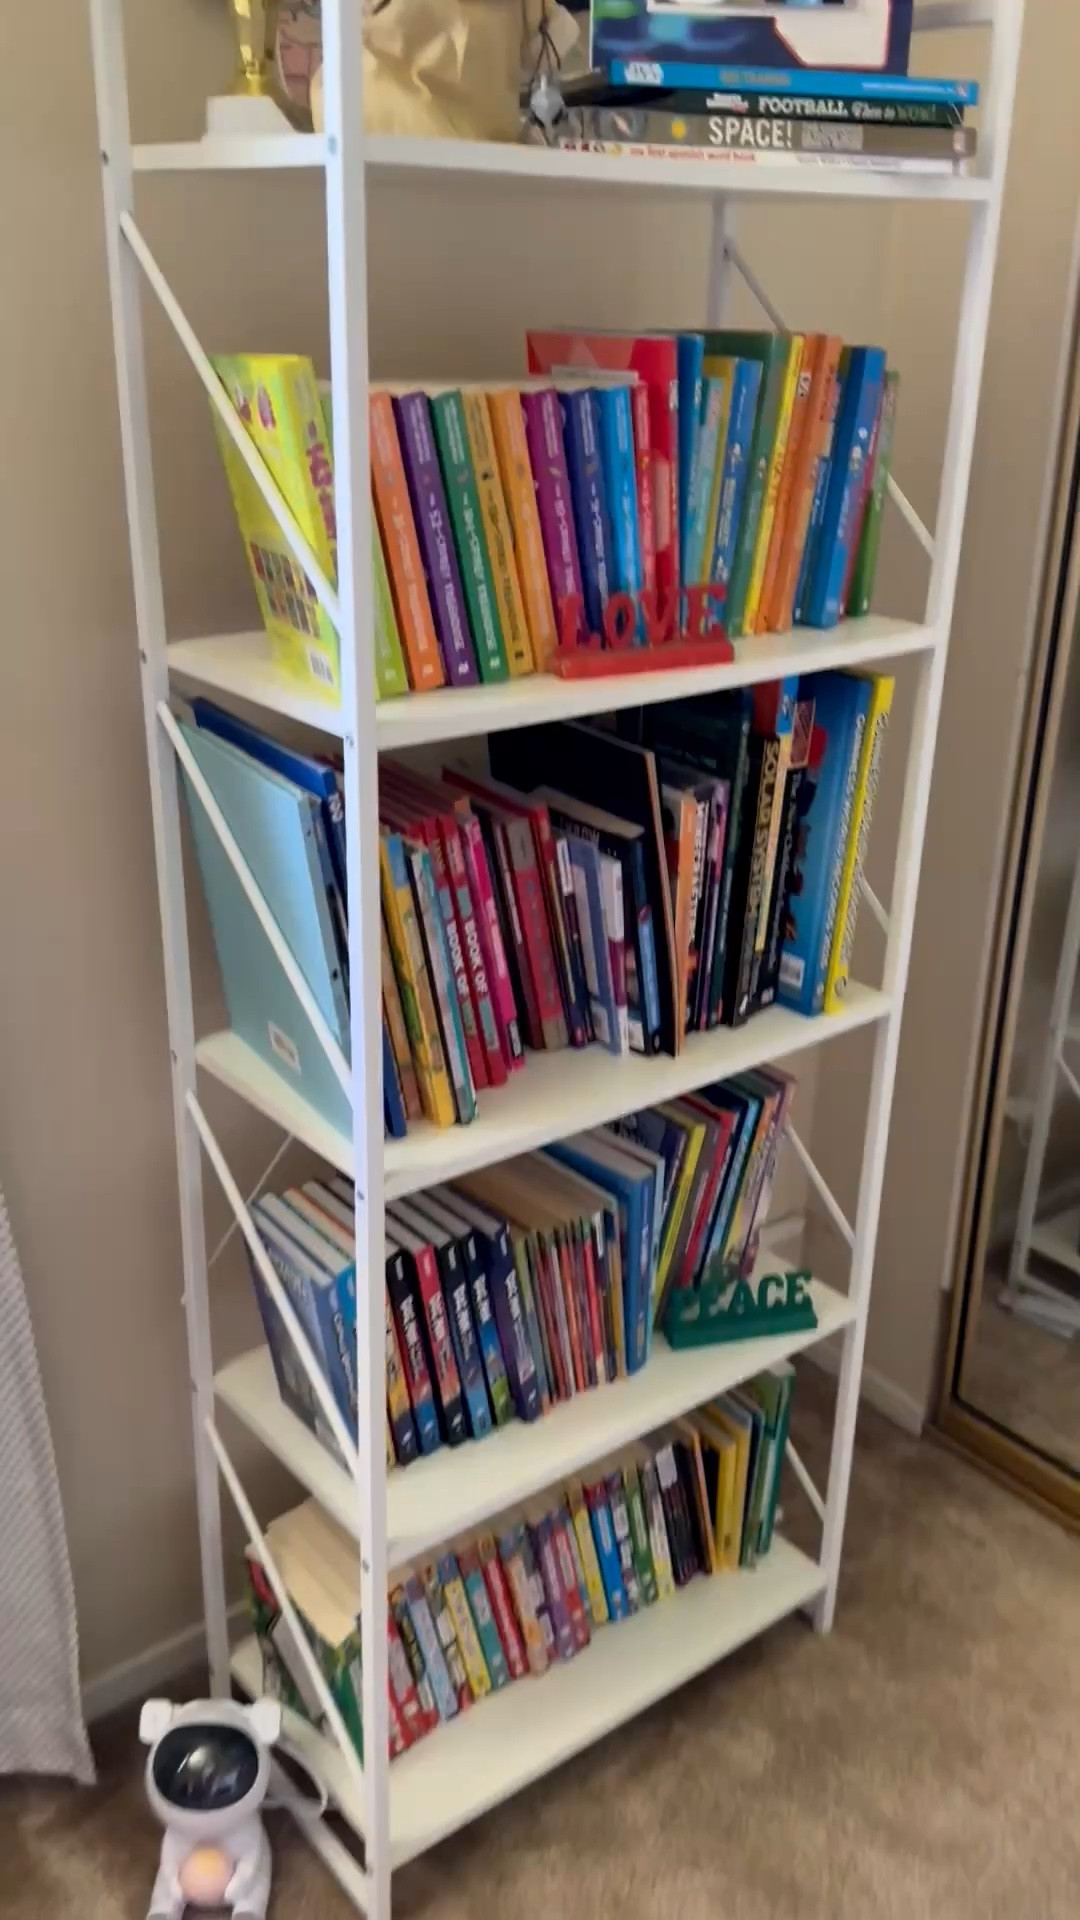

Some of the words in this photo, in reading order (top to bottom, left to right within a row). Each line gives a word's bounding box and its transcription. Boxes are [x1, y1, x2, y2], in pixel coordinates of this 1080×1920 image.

[708, 115, 793, 149] SPACE!
[758, 95, 849, 118] FOOTBALL
[557, 584, 728, 653] LOVE
[447, 920, 464, 974] BOOK
[457, 973, 470, 996] OF
[465, 919, 482, 972] BOOK
[475, 971, 489, 993] OF
